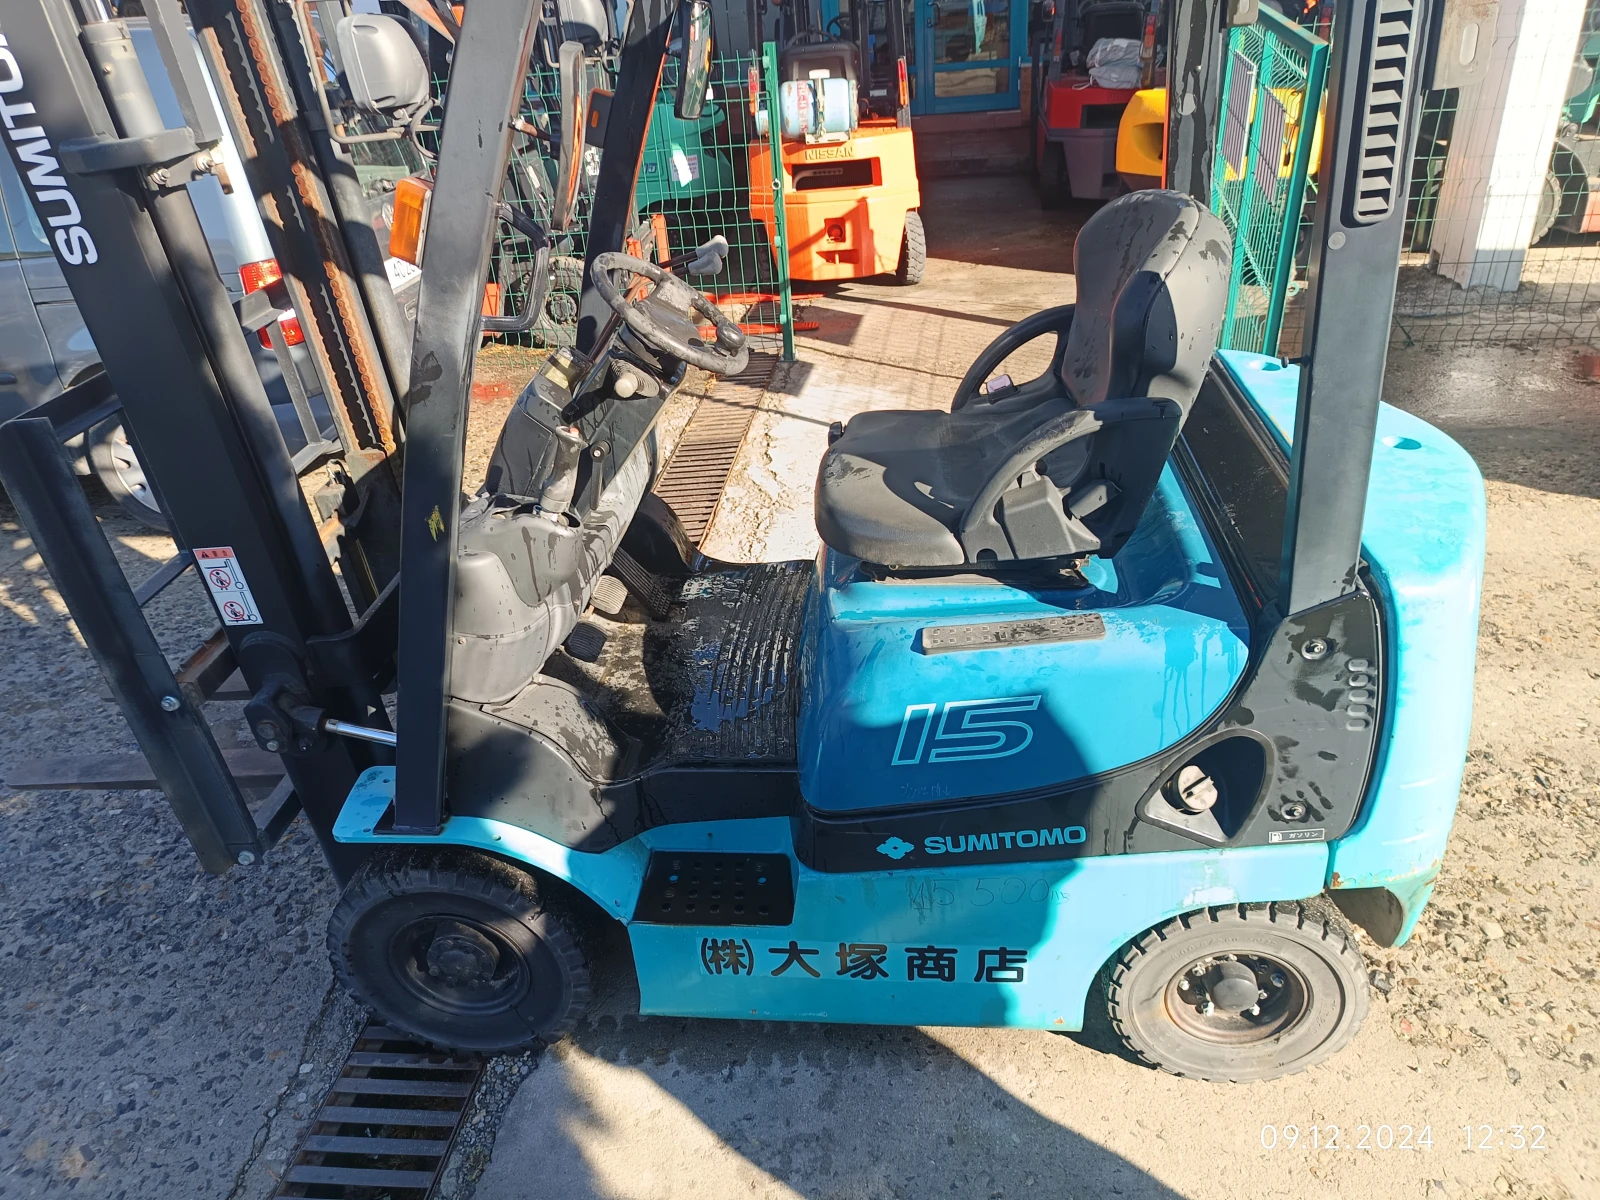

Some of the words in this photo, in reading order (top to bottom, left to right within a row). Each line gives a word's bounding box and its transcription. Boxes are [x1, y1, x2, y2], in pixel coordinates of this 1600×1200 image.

[805, 147, 854, 160] NISSAN
[891, 695, 1041, 766] 15
[924, 826, 1086, 855] SUMITOMO
